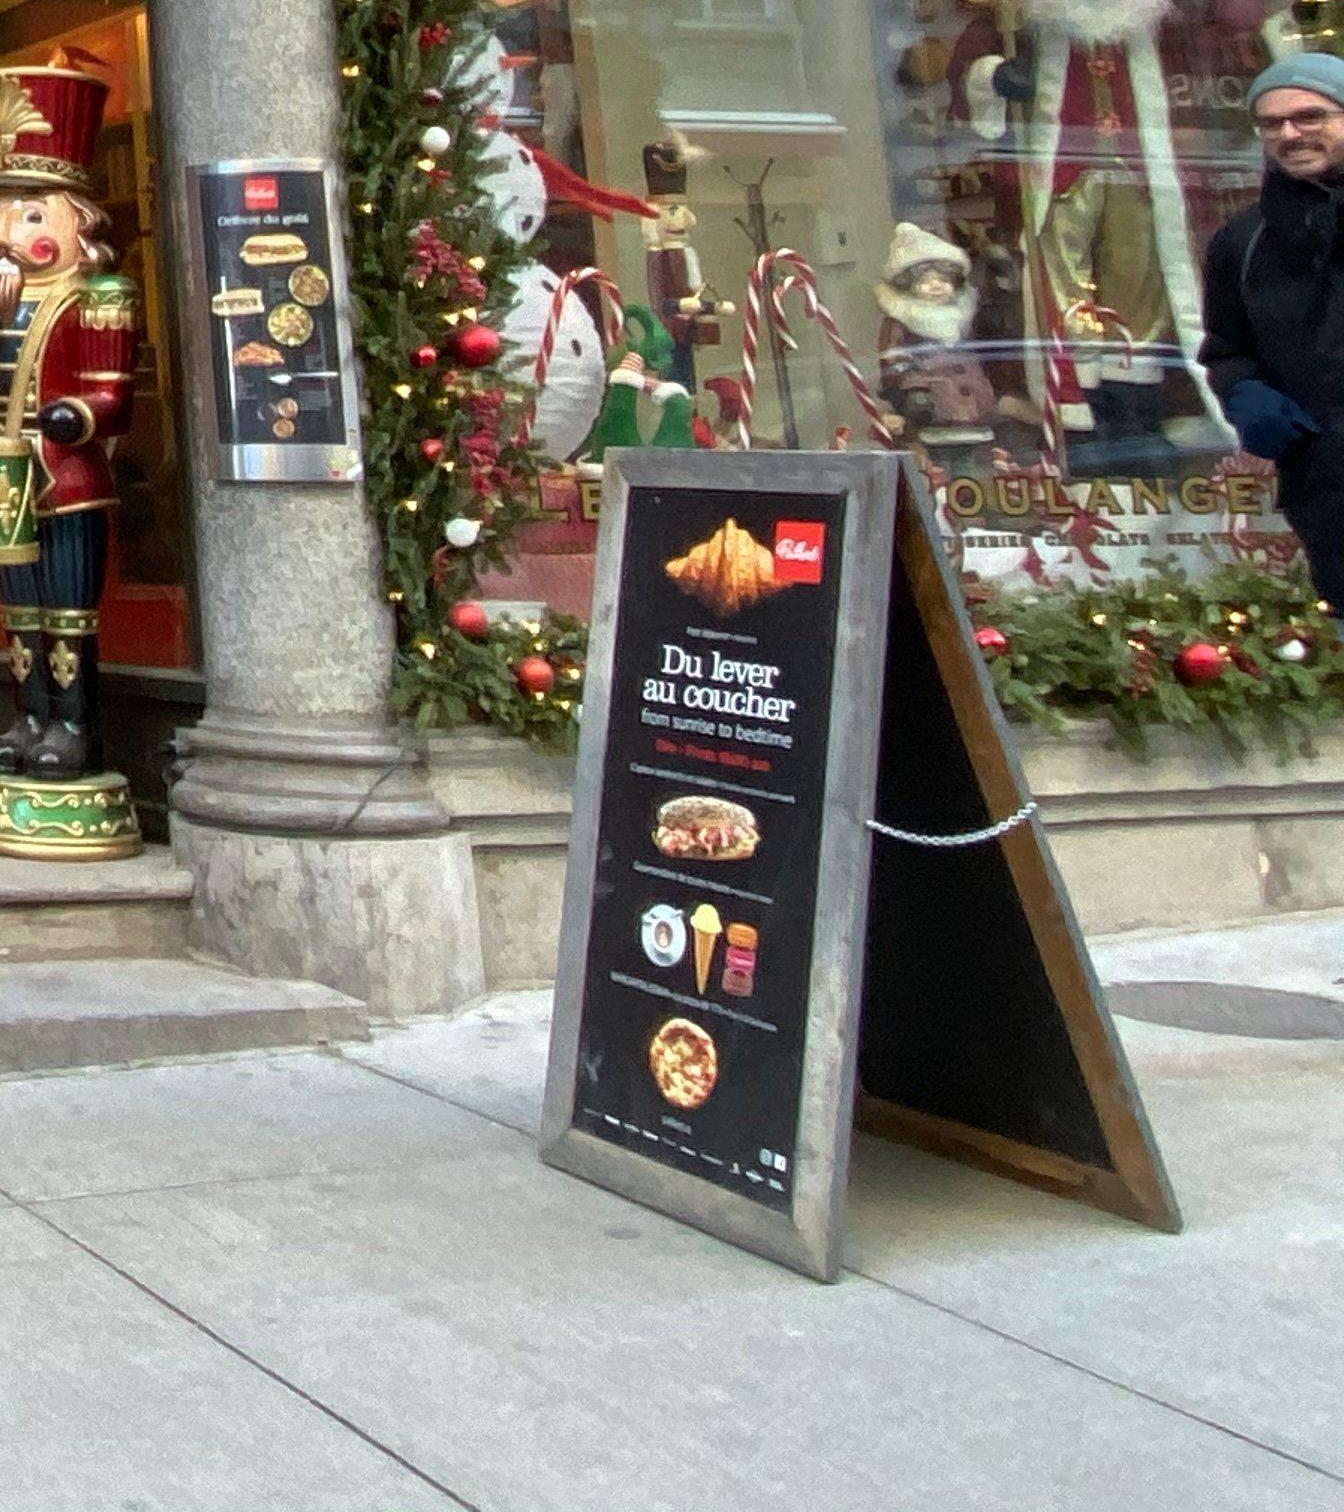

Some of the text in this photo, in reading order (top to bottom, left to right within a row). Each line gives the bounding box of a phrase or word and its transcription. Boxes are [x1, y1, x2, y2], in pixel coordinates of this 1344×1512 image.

[660, 644, 781, 690] Du lever
[641, 678, 797, 724] au coucher
[640, 707, 671, 728] from
[717, 722, 734, 739] to
[733, 722, 794, 750] bedtime
